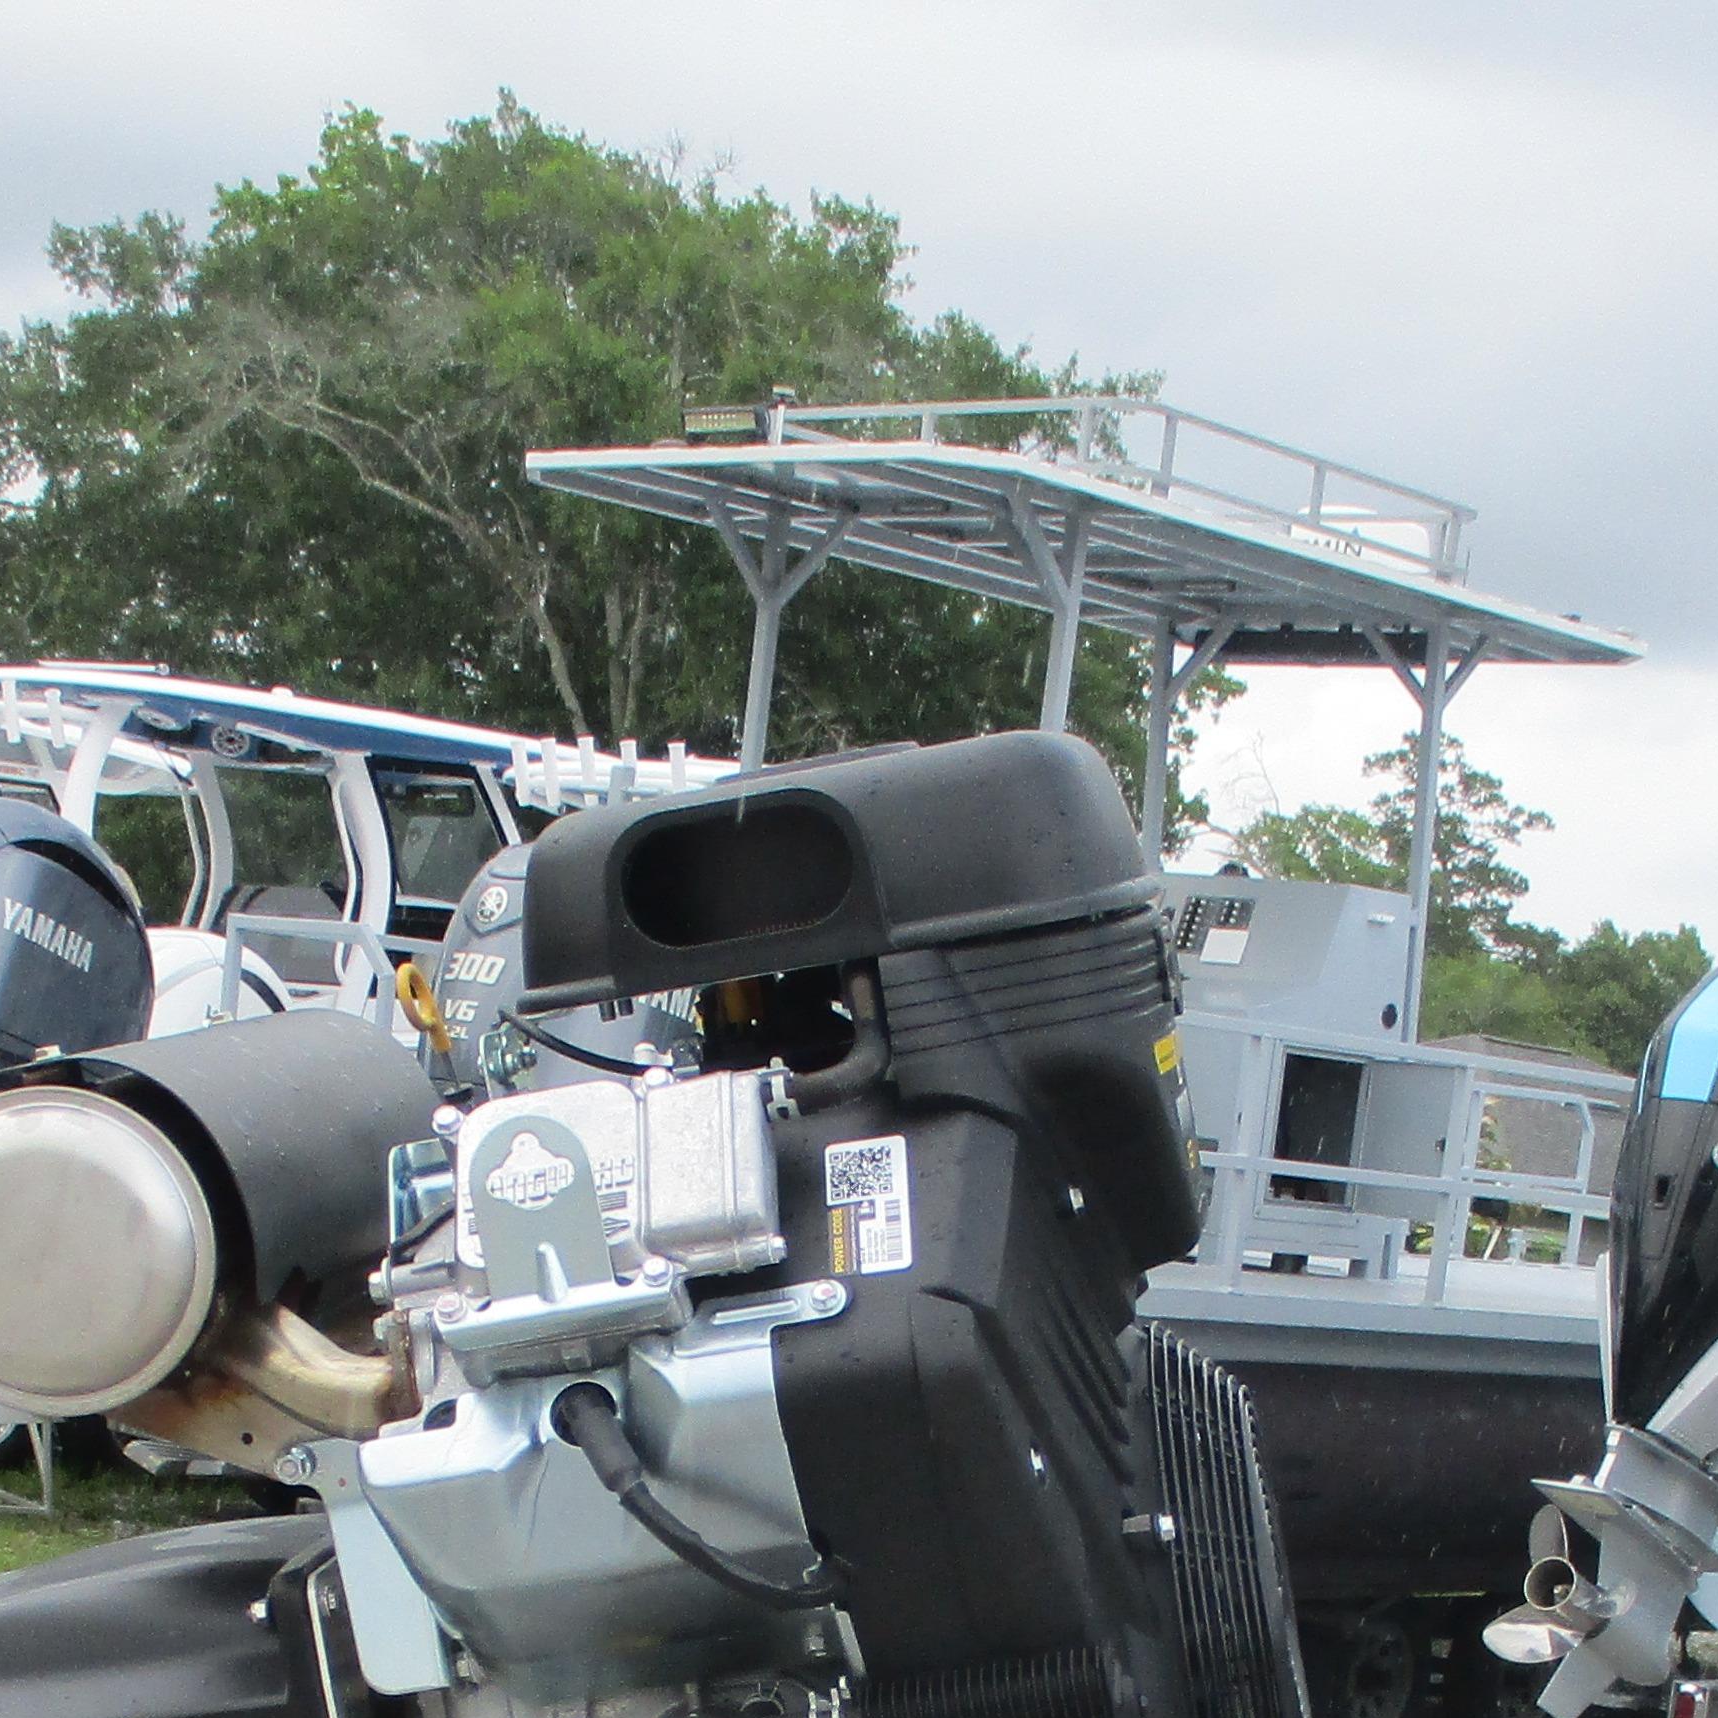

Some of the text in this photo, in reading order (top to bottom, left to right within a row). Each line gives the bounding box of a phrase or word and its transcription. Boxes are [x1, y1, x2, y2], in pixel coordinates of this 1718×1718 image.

[2, 898, 94, 973] YAMAHA
[443, 951, 506, 985] 300
[443, 999, 479, 1022] V6
